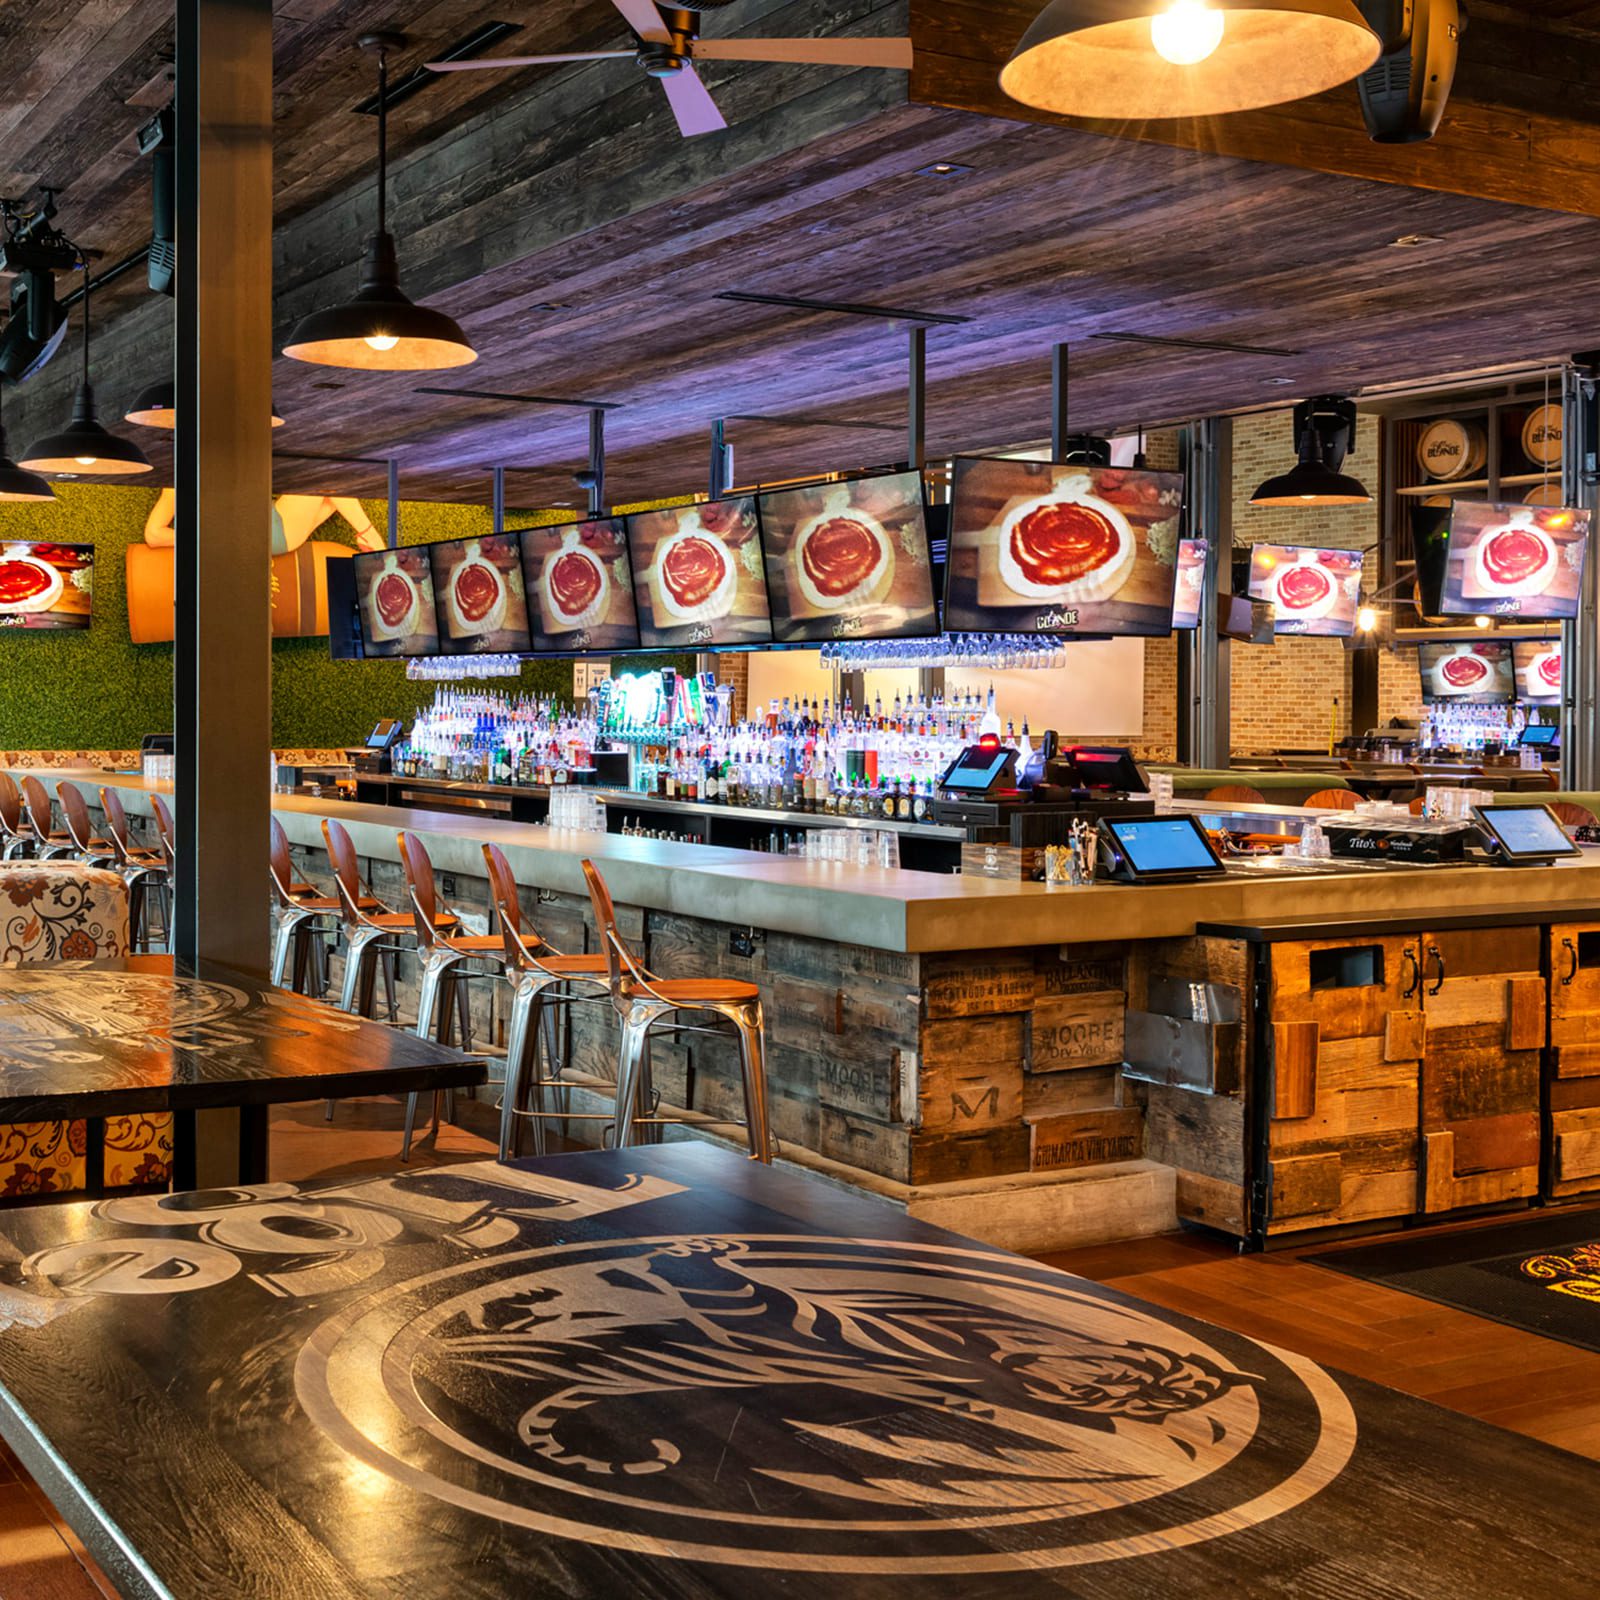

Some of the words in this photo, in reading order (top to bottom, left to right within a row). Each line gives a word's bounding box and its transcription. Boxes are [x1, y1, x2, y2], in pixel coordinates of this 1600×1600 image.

[1349, 838, 1376, 850] Tito's
[1043, 1021, 1113, 1045] MOORE
[826, 1062, 883, 1093] MOORE
